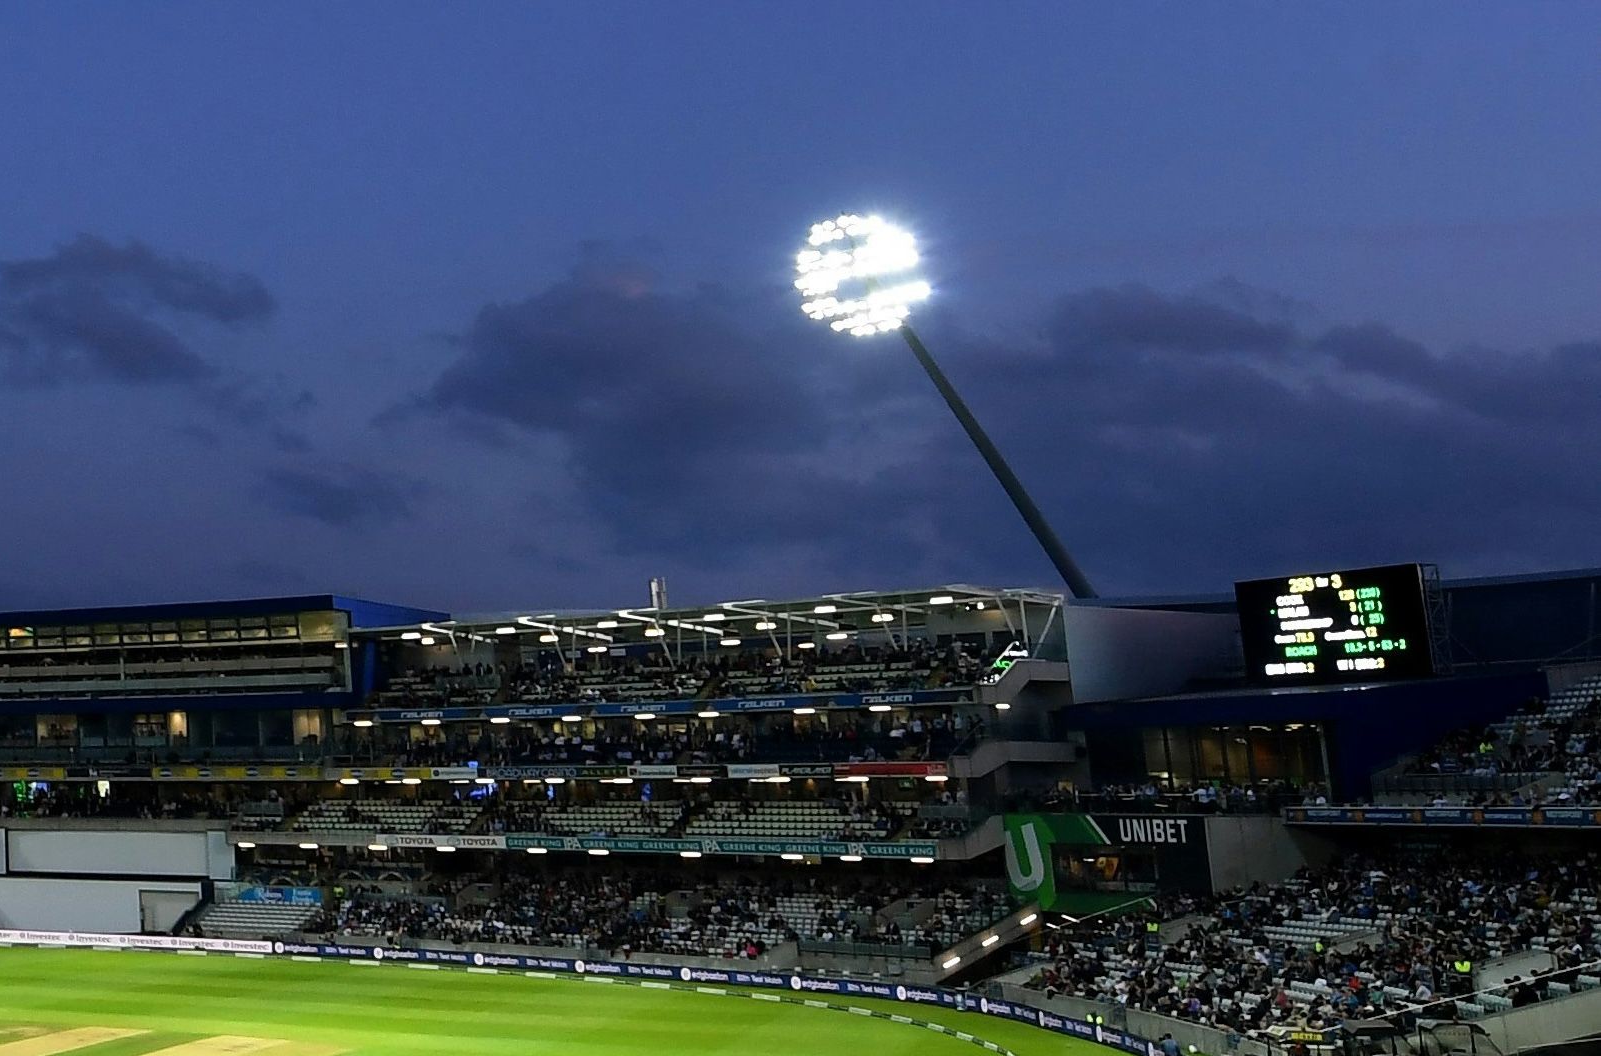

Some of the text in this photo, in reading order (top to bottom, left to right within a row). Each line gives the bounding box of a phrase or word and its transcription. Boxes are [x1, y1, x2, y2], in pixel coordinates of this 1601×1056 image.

[1331, 574, 1342, 588] 3
[862, 695, 912, 704] FALKEN
[621, 703, 665, 712] FALKEN
[738, 700, 785, 709] FALKEN
[508, 707, 553, 716] FALKEN
[1118, 818, 1188, 844] UNIBET
[399, 837, 435, 845] TOYOTA
[461, 838, 497, 846] TOYOTA
[508, 839, 562, 848] GREENE KING
[564, 839, 582, 850] IPA
[583, 840, 638, 849] GREENE KING
[643, 841, 698, 850] GREENE KING
[702, 840, 721, 852] IPA
[723, 842, 781, 852] GREENE KING
[785, 843, 845, 853] GREENE KING
[848, 844, 867, 856] IPA
[869, 844, 933, 855] GREENE KING
[1005, 822, 1044, 891] U
[231, 941, 268, 950] Investec
